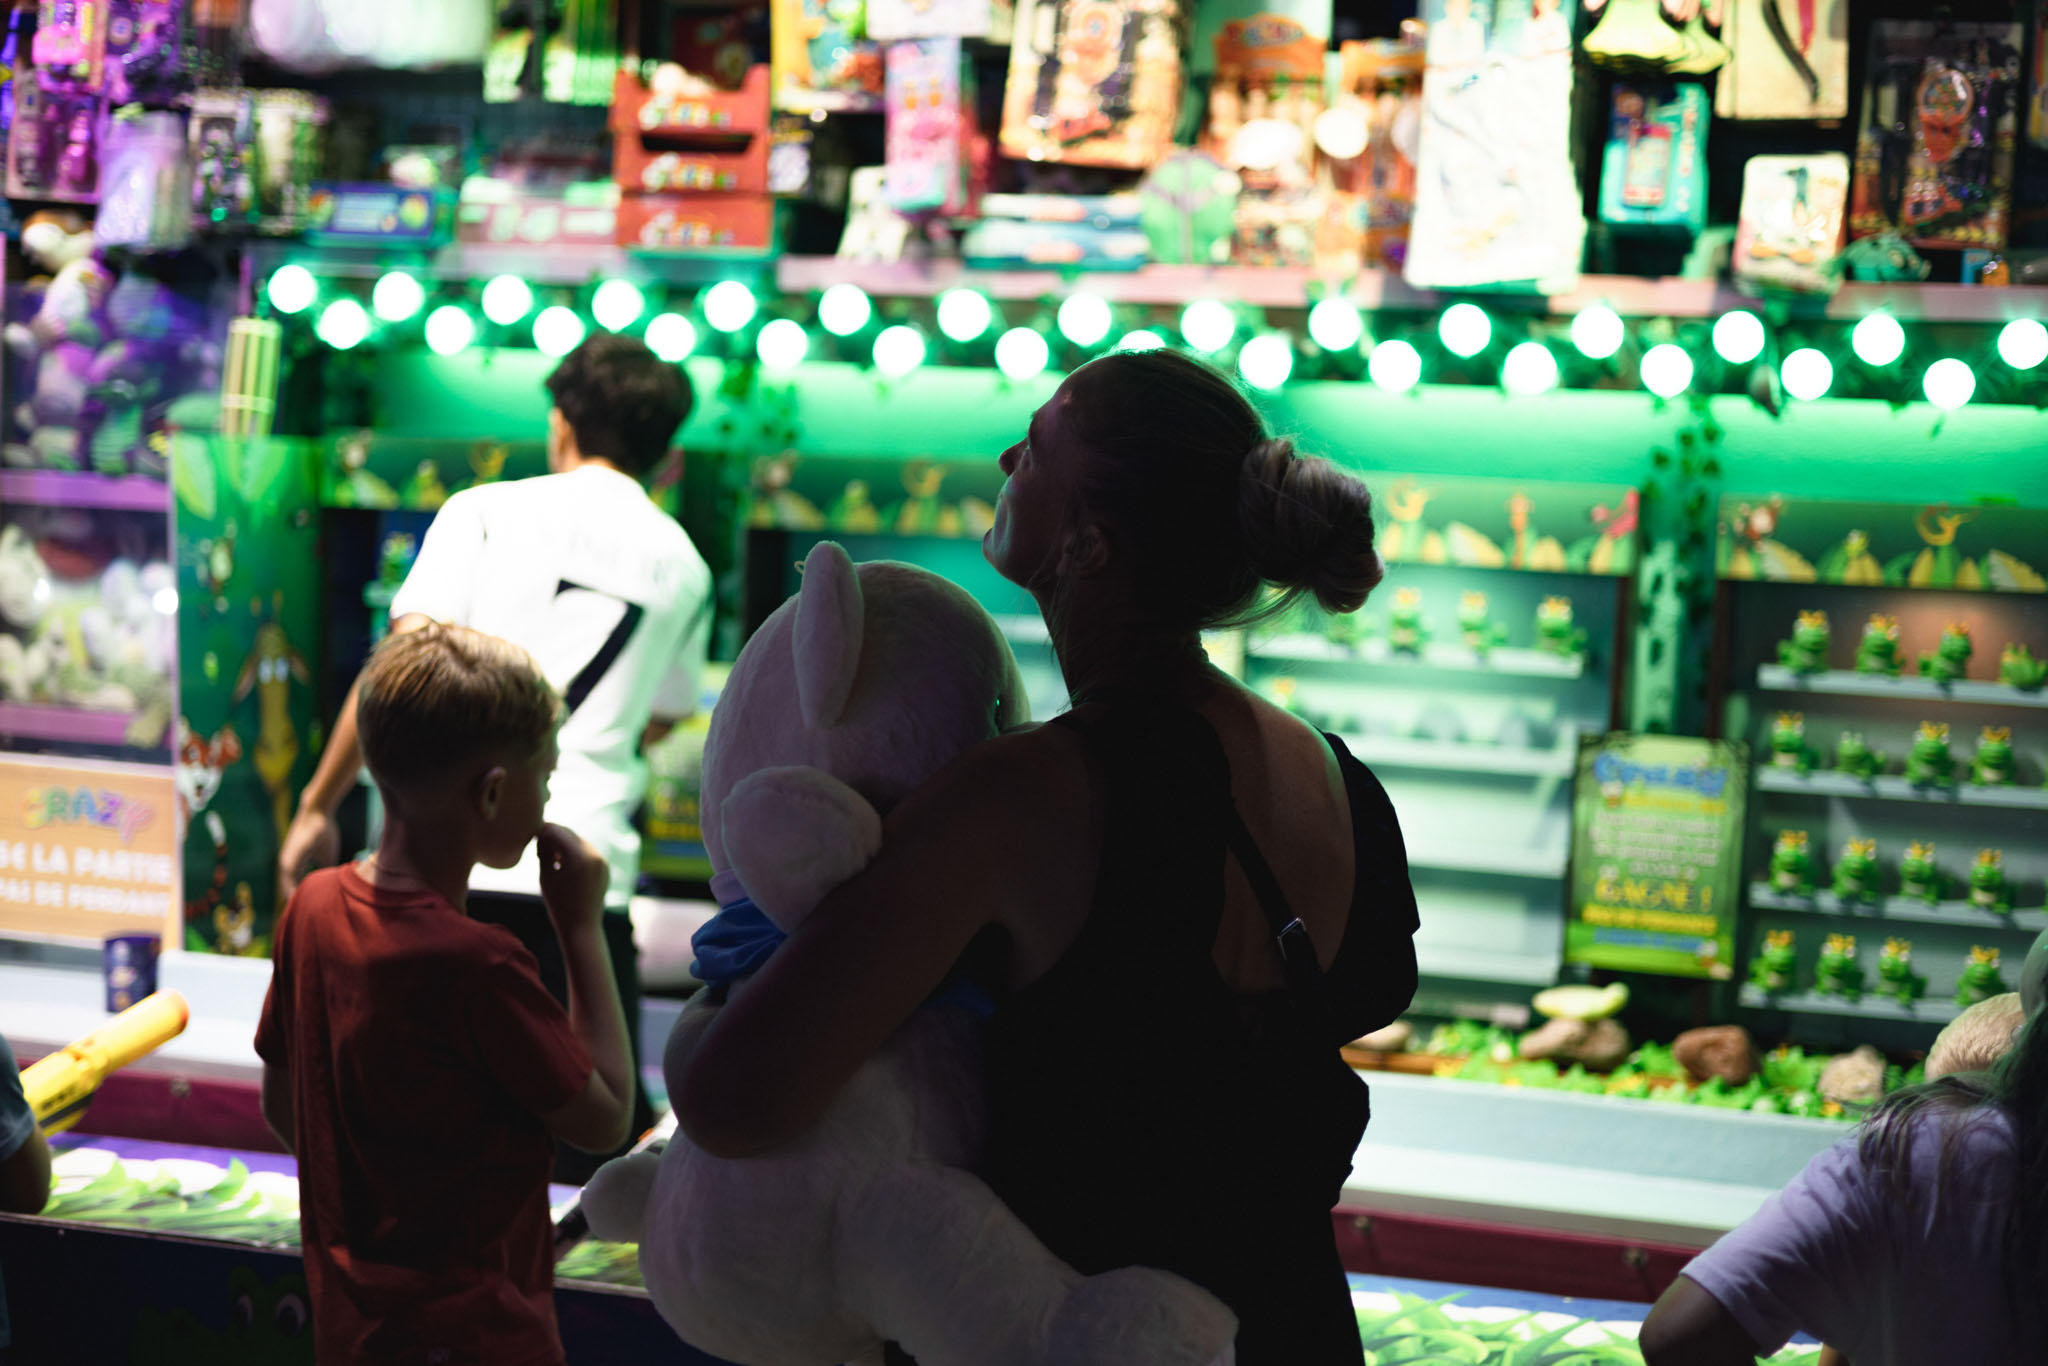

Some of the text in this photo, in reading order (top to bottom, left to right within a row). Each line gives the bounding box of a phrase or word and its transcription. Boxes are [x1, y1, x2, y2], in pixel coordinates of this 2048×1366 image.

[553, 577, 645, 715] 7
[32, 842, 69, 875] LA
[74, 846, 171, 884] PARTIE
[34, 880, 65, 907] DE
